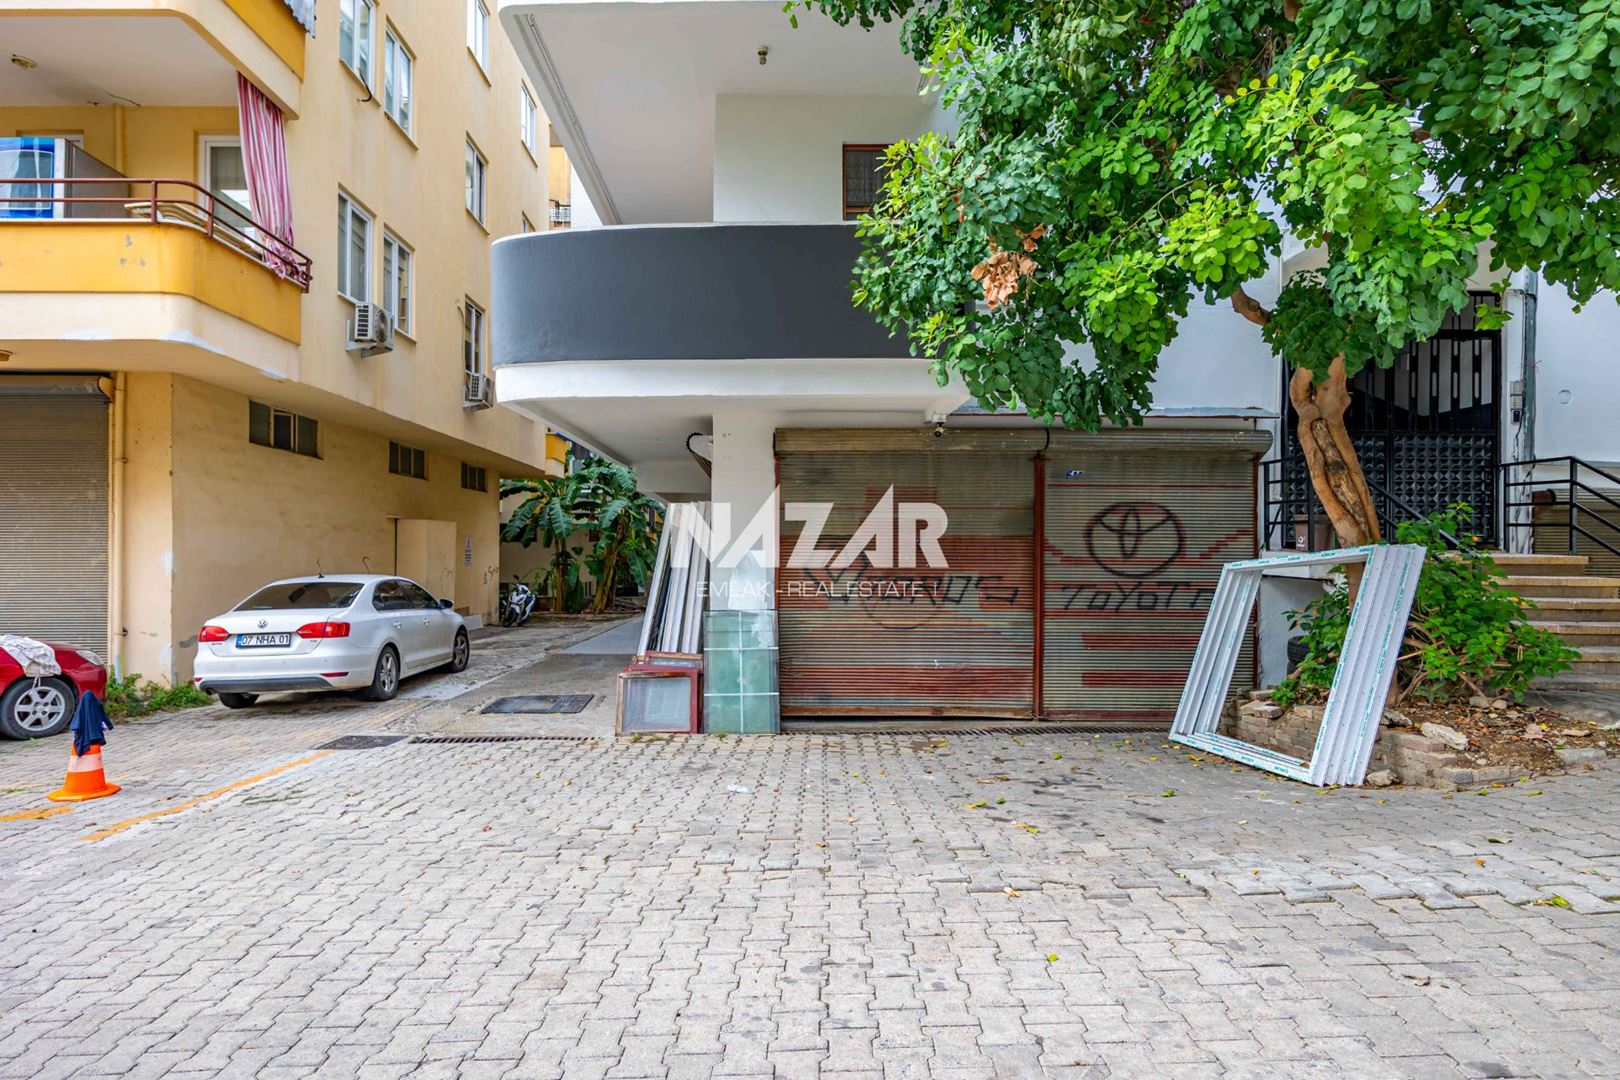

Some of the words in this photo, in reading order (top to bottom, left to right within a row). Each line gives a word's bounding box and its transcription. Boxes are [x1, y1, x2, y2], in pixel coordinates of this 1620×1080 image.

[241, 636, 254, 645] 07
[255, 635, 276, 644] NHA
[278, 634, 290, 642] 01
